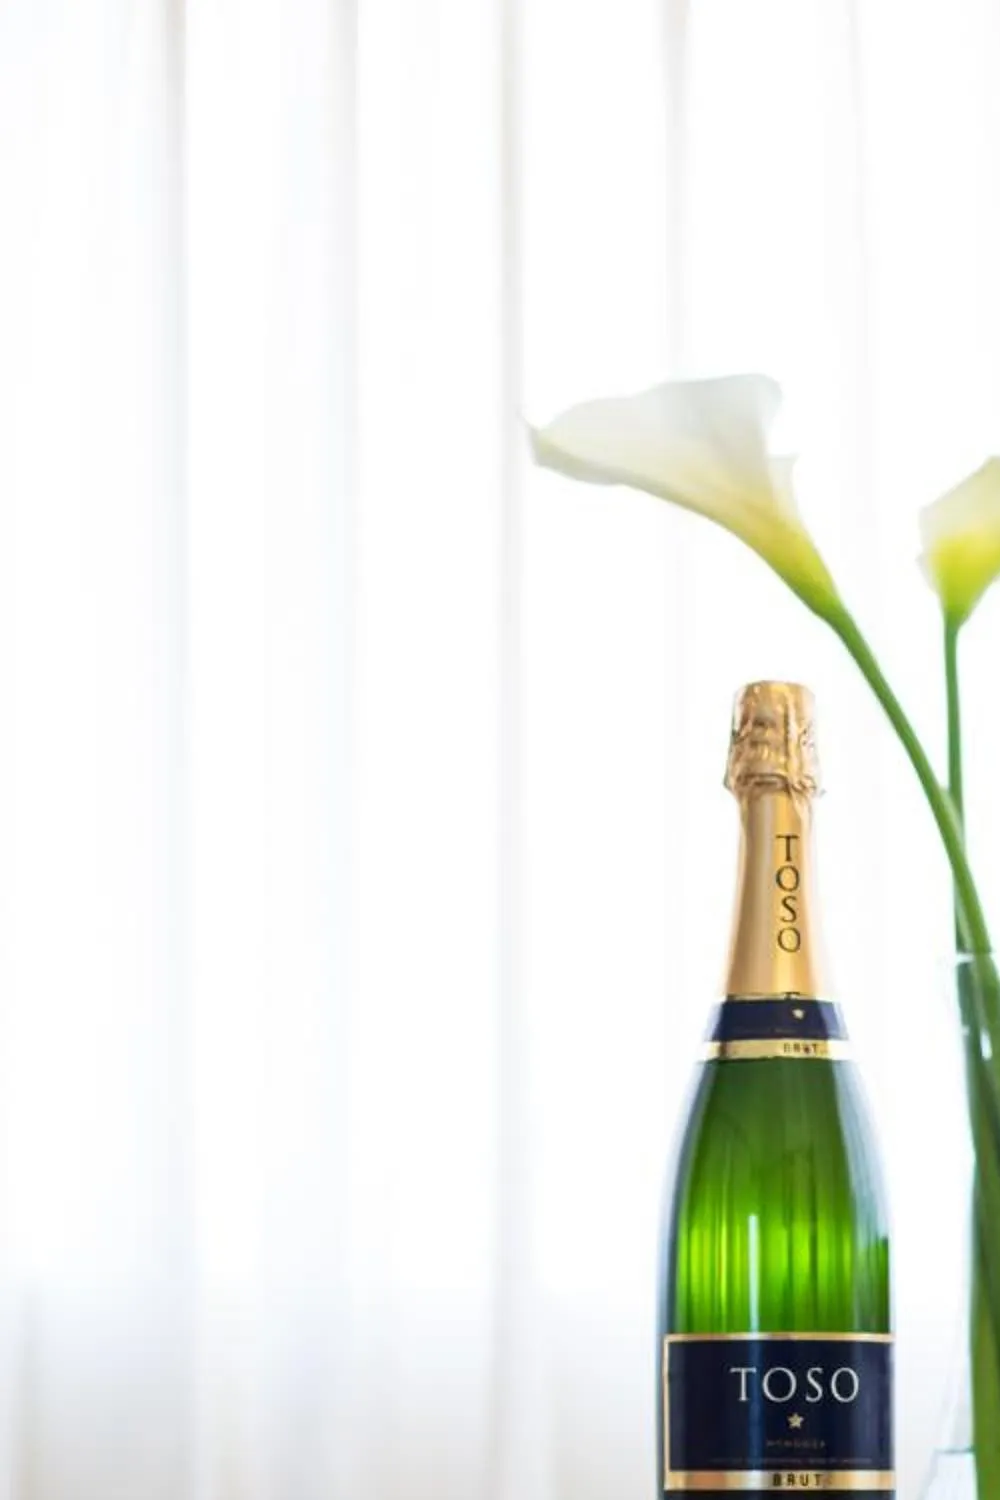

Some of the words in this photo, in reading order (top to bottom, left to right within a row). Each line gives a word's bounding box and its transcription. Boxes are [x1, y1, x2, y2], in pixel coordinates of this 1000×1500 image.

[775, 834, 801, 953] TOSO
[730, 1366, 861, 1403] TOSO
[771, 1474, 823, 1488] BRUT
